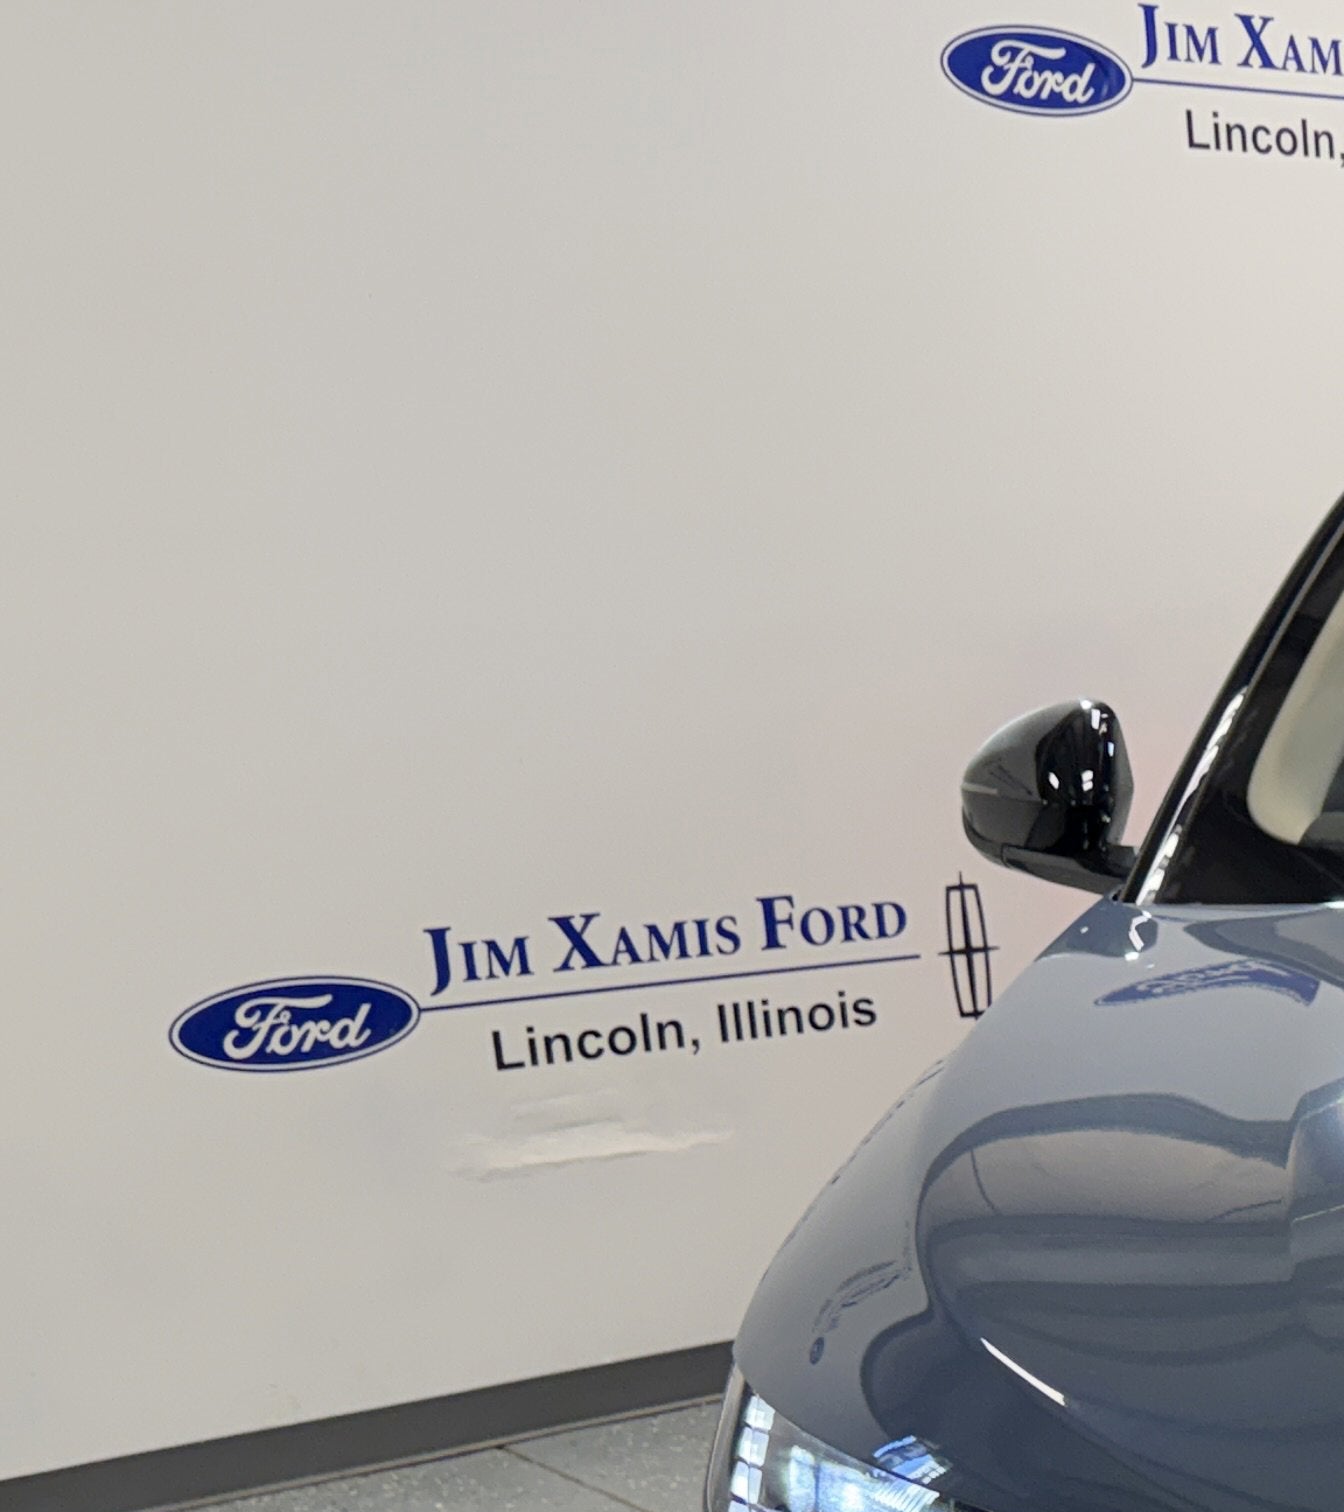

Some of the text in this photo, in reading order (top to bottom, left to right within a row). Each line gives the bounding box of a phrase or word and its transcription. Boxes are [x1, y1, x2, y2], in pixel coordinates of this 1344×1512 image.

[1138, 3, 1220, 69] JIM
[982, 39, 1095, 104] Ford
[422, 894, 907, 997] JIM XAMIS FORD
[223, 994, 371, 1060] Ford
[491, 990, 877, 1072] Lincoln, Illinois
